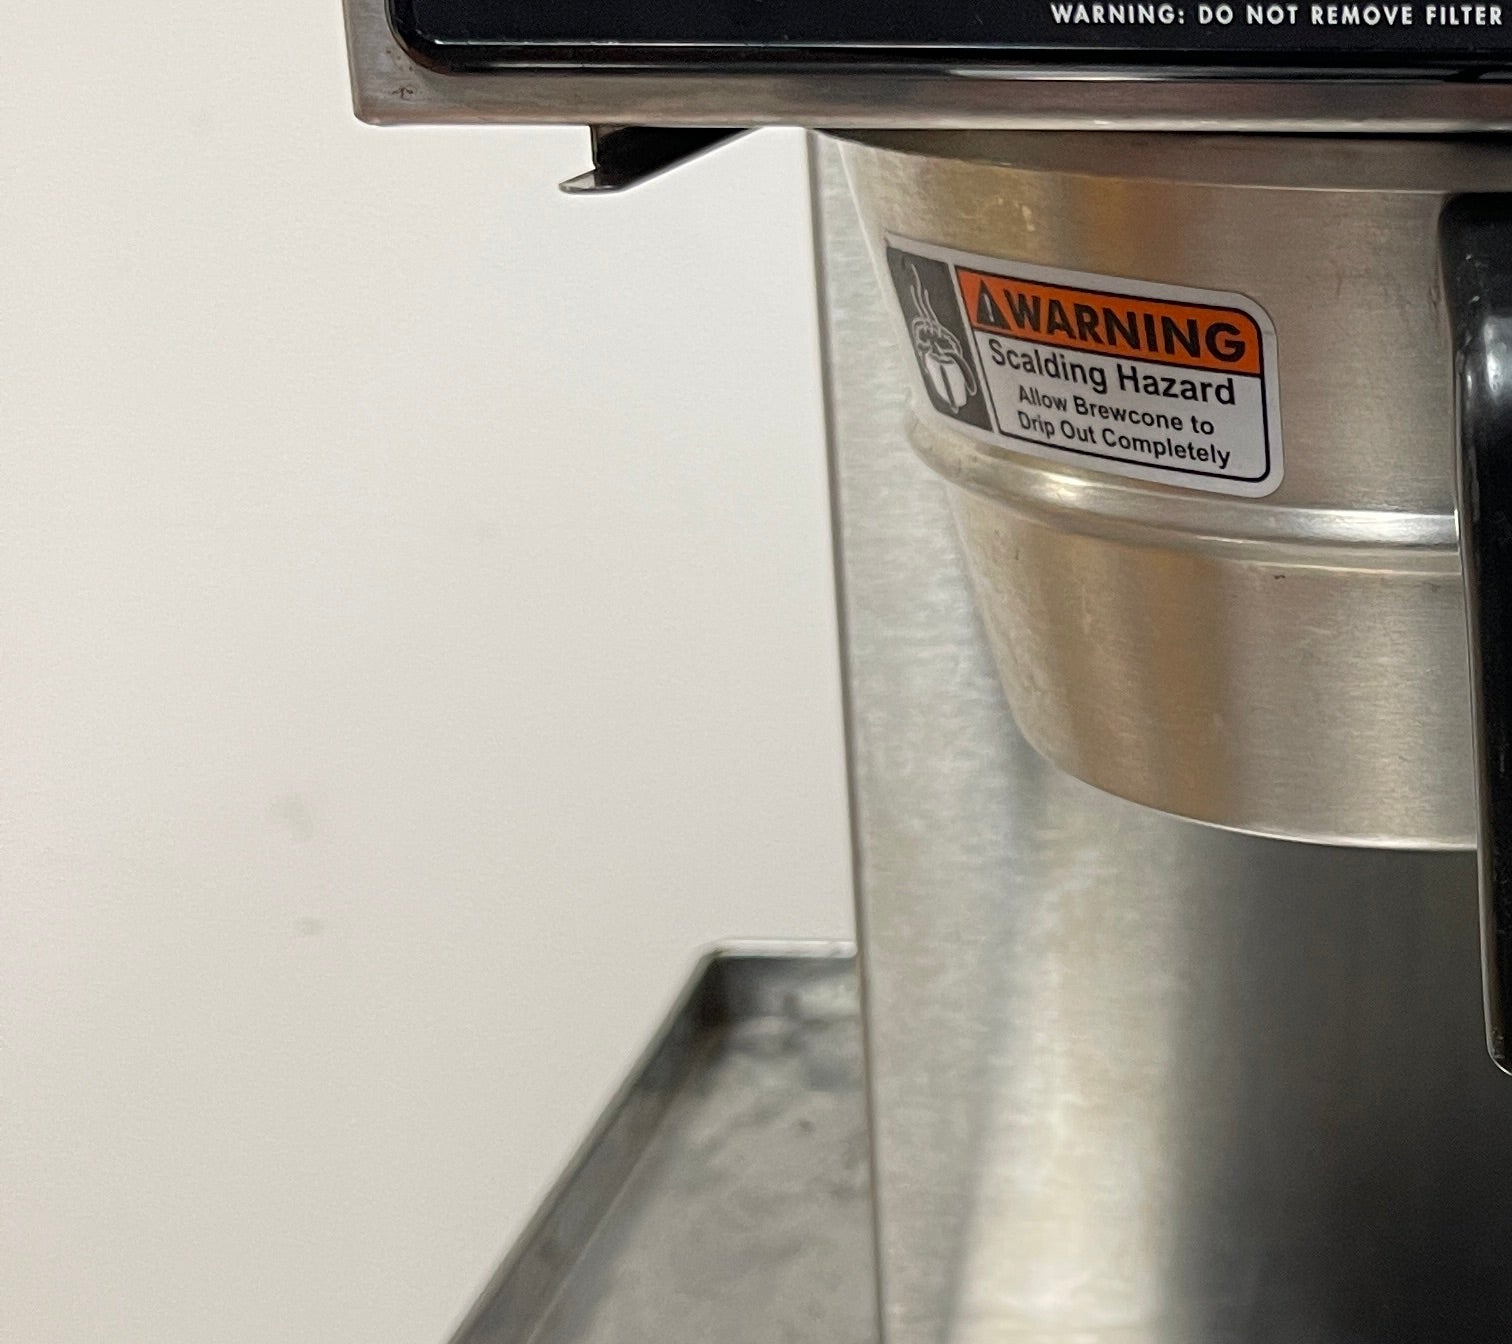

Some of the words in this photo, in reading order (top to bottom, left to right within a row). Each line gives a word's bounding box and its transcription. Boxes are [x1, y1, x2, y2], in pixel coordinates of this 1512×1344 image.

[1051, 3, 1185, 26] WARNING:
[1198, 4, 1235, 26] DO
[1246, 4, 1298, 26] NOT
[1311, 4, 1413, 26] REMOVE
[1426, 4, 1503, 26] FILTER
[1002, 288, 1246, 363] WARNING
[989, 338, 1108, 394] Scalding
[1116, 363, 1236, 405] Hazard
[1018, 385, 1068, 412] Allow
[1076, 394, 1183, 433] Brewcone
[1191, 417, 1214, 436] to
[1017, 411, 1055, 438] Drip
[1061, 422, 1097, 444] Out
[1103, 429, 1231, 469] Completely
